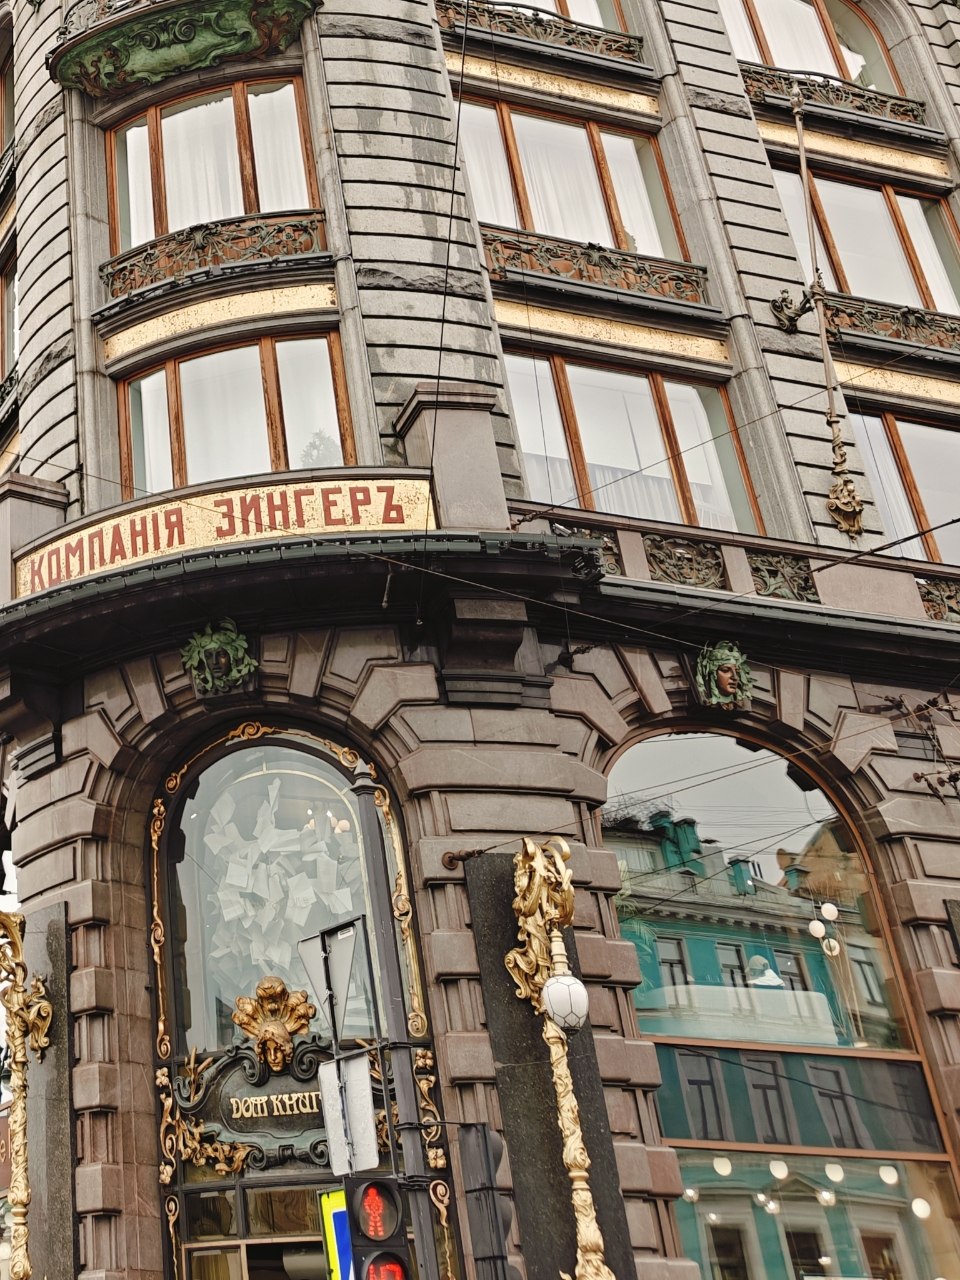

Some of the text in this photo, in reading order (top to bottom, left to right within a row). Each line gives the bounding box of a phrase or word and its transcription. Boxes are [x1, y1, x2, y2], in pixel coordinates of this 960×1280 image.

[31, 486, 405, 593] КОМПАНІЯ ЗИНГЕРЪ
[270, 1091, 321, 1116] КНИГ
